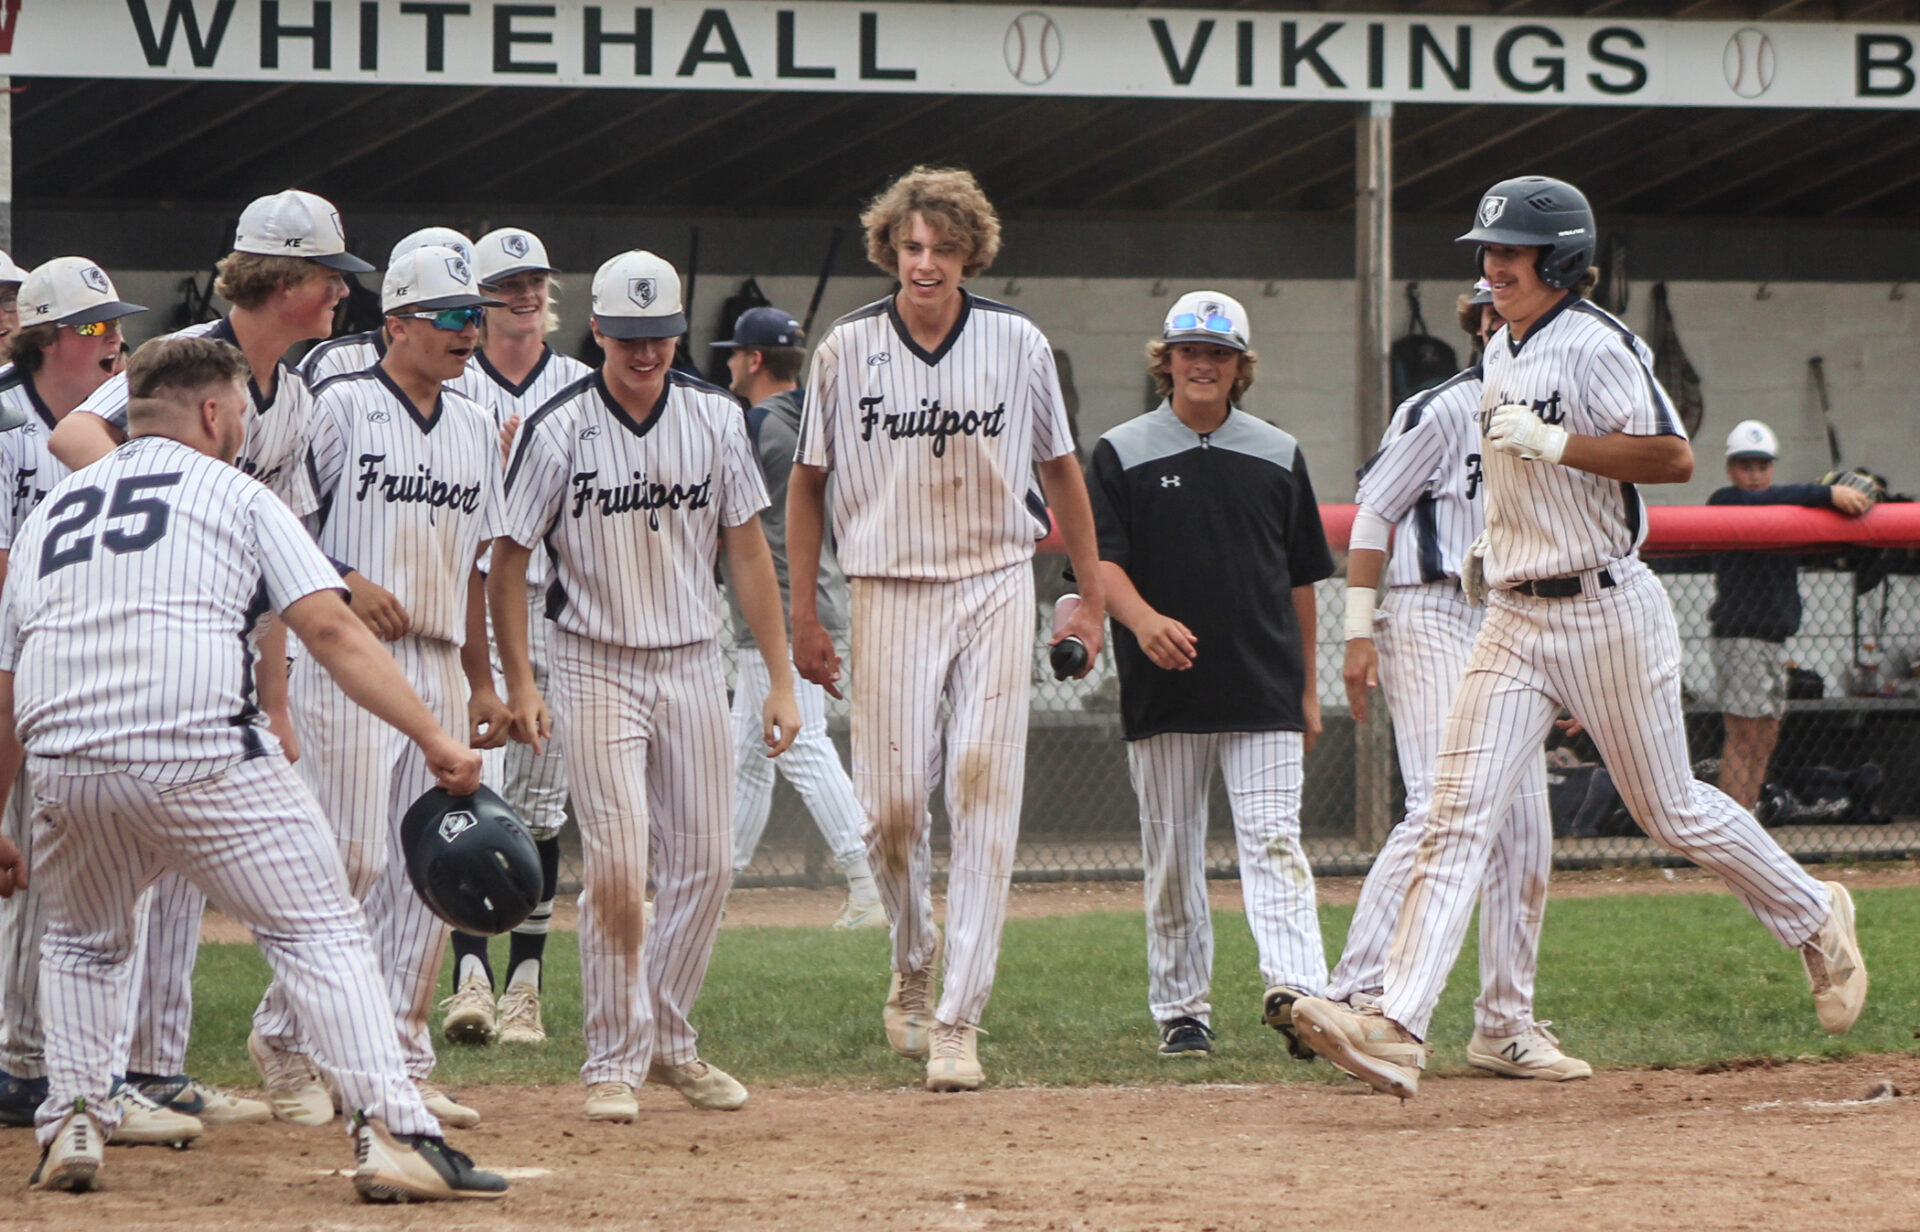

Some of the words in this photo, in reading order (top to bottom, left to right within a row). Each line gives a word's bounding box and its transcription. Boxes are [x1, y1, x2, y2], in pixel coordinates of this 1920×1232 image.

[126, 0, 917, 80] WHITEHALL
[1147, 18, 1648, 95] VIKINGS
[1855, 33, 1916, 97] B
[858, 395, 1006, 458] Fruitport
[39, 470, 184, 580] 25
[356, 453, 481, 527] Fruitport
[572, 467, 712, 532] Fruitport
